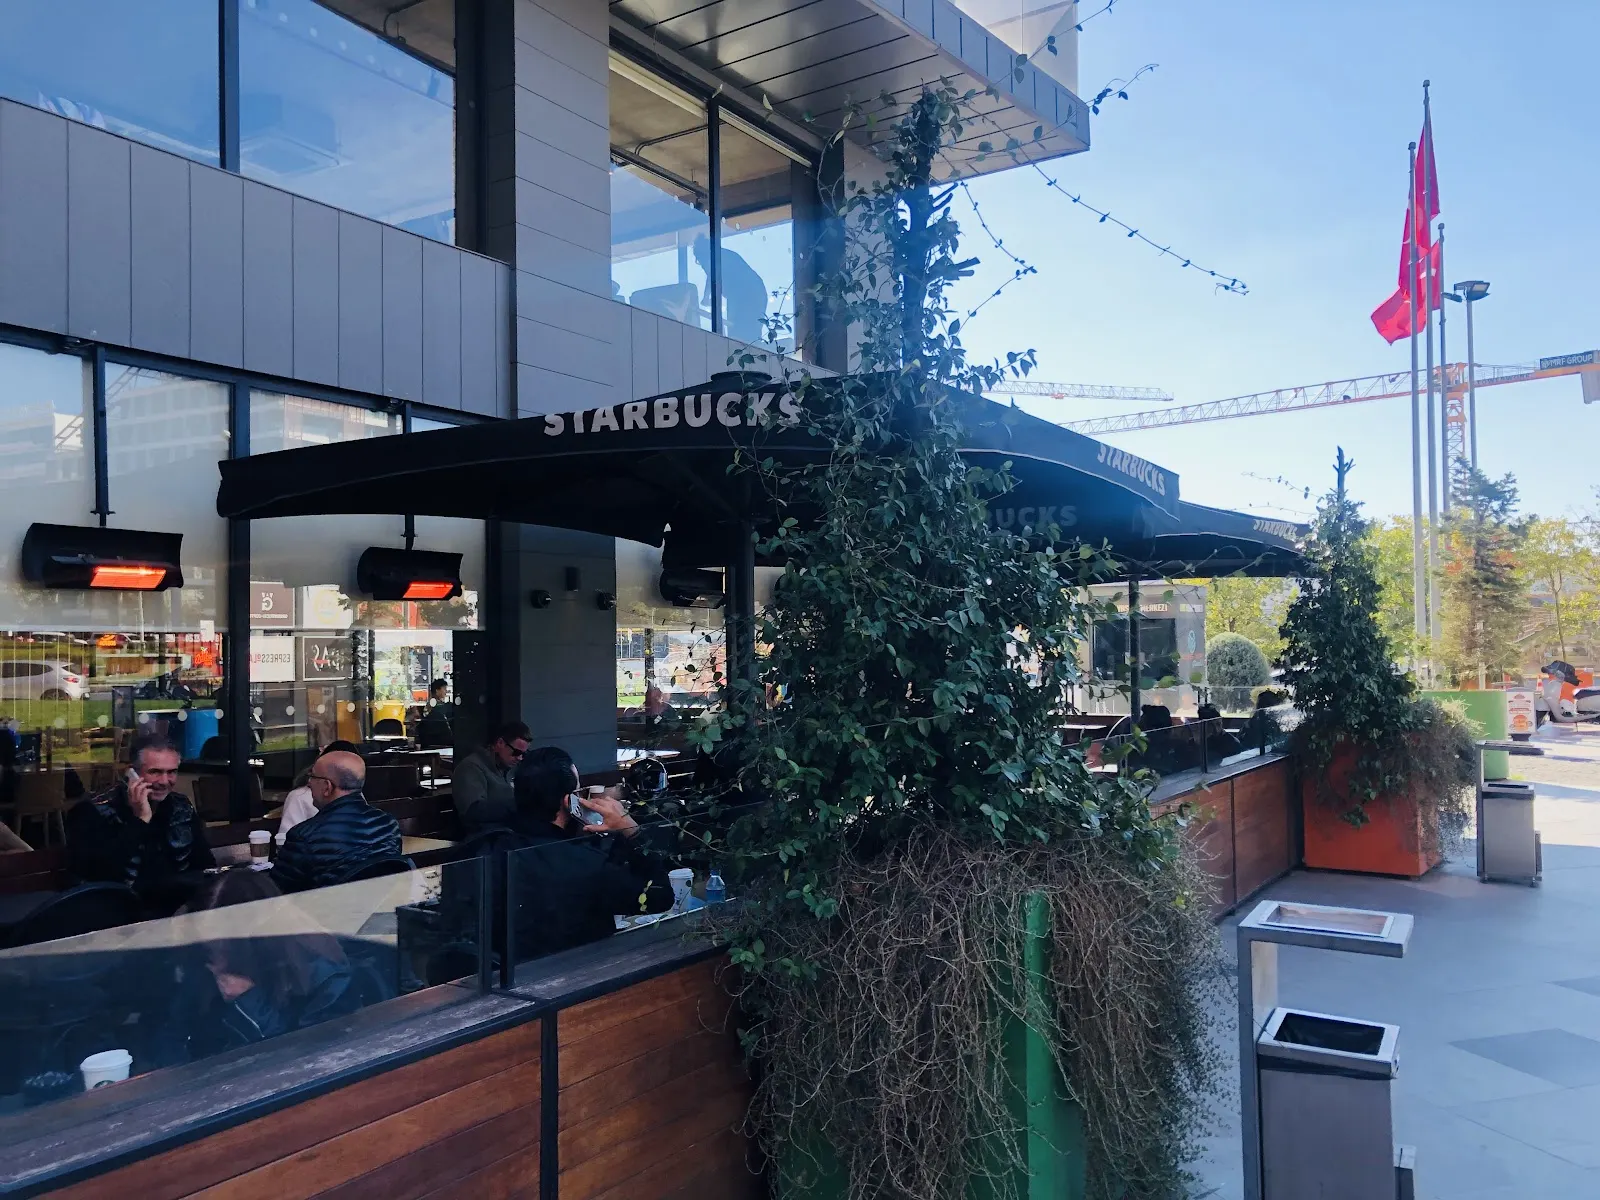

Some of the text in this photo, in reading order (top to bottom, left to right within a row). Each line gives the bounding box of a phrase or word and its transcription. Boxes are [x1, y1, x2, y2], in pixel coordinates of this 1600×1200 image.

[1566, 353, 1593, 365] GROUP
[543, 392, 804, 437] STARBUCKS
[1097, 443, 1166, 497] STARBUCKS
